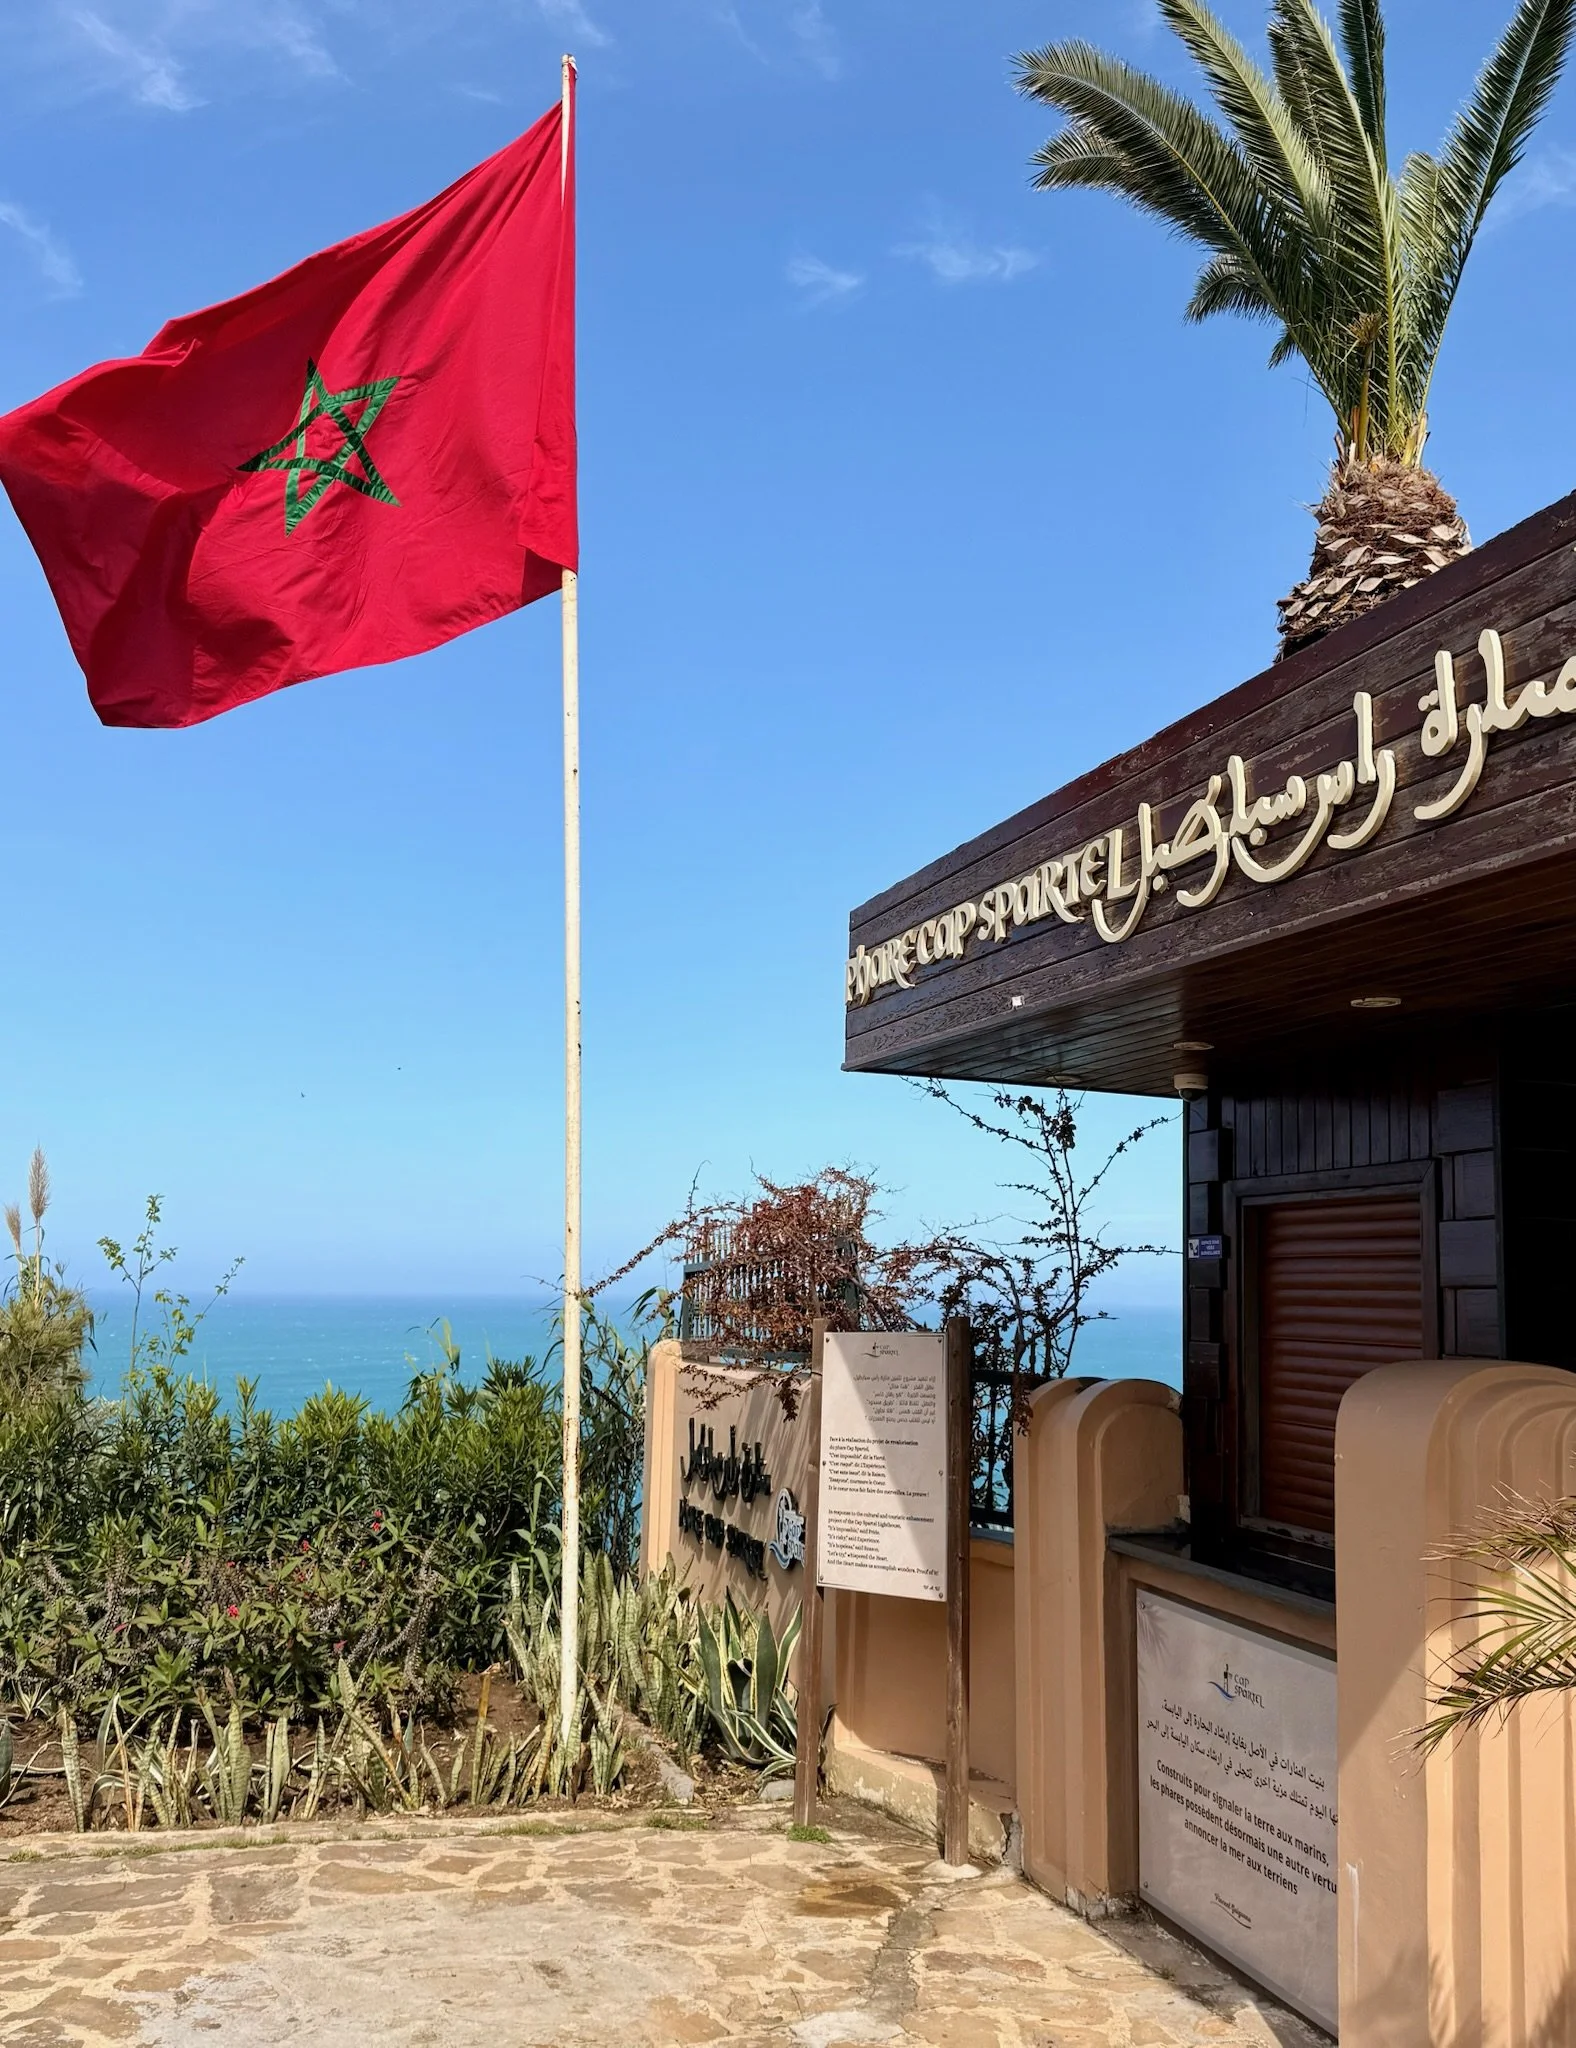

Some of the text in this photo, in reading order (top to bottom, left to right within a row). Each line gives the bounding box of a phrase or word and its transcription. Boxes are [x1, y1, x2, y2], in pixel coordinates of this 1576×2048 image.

[1193, 1714, 1212, 1735] البحارة
[1224, 1756, 1233, 1775] في
[1269, 1752, 1278, 1771] في
[1280, 1759, 1307, 1779] المنارات
[1157, 1759, 1329, 1867] Construits pour signaler la terre aux marins,
[1309, 1803, 1326, 1820] اليوم
[1150, 1774, 1337, 1894] les phares possèdent désormais une autre vertu
[1185, 1819, 1298, 1895] annoncer la mer aux terriens
